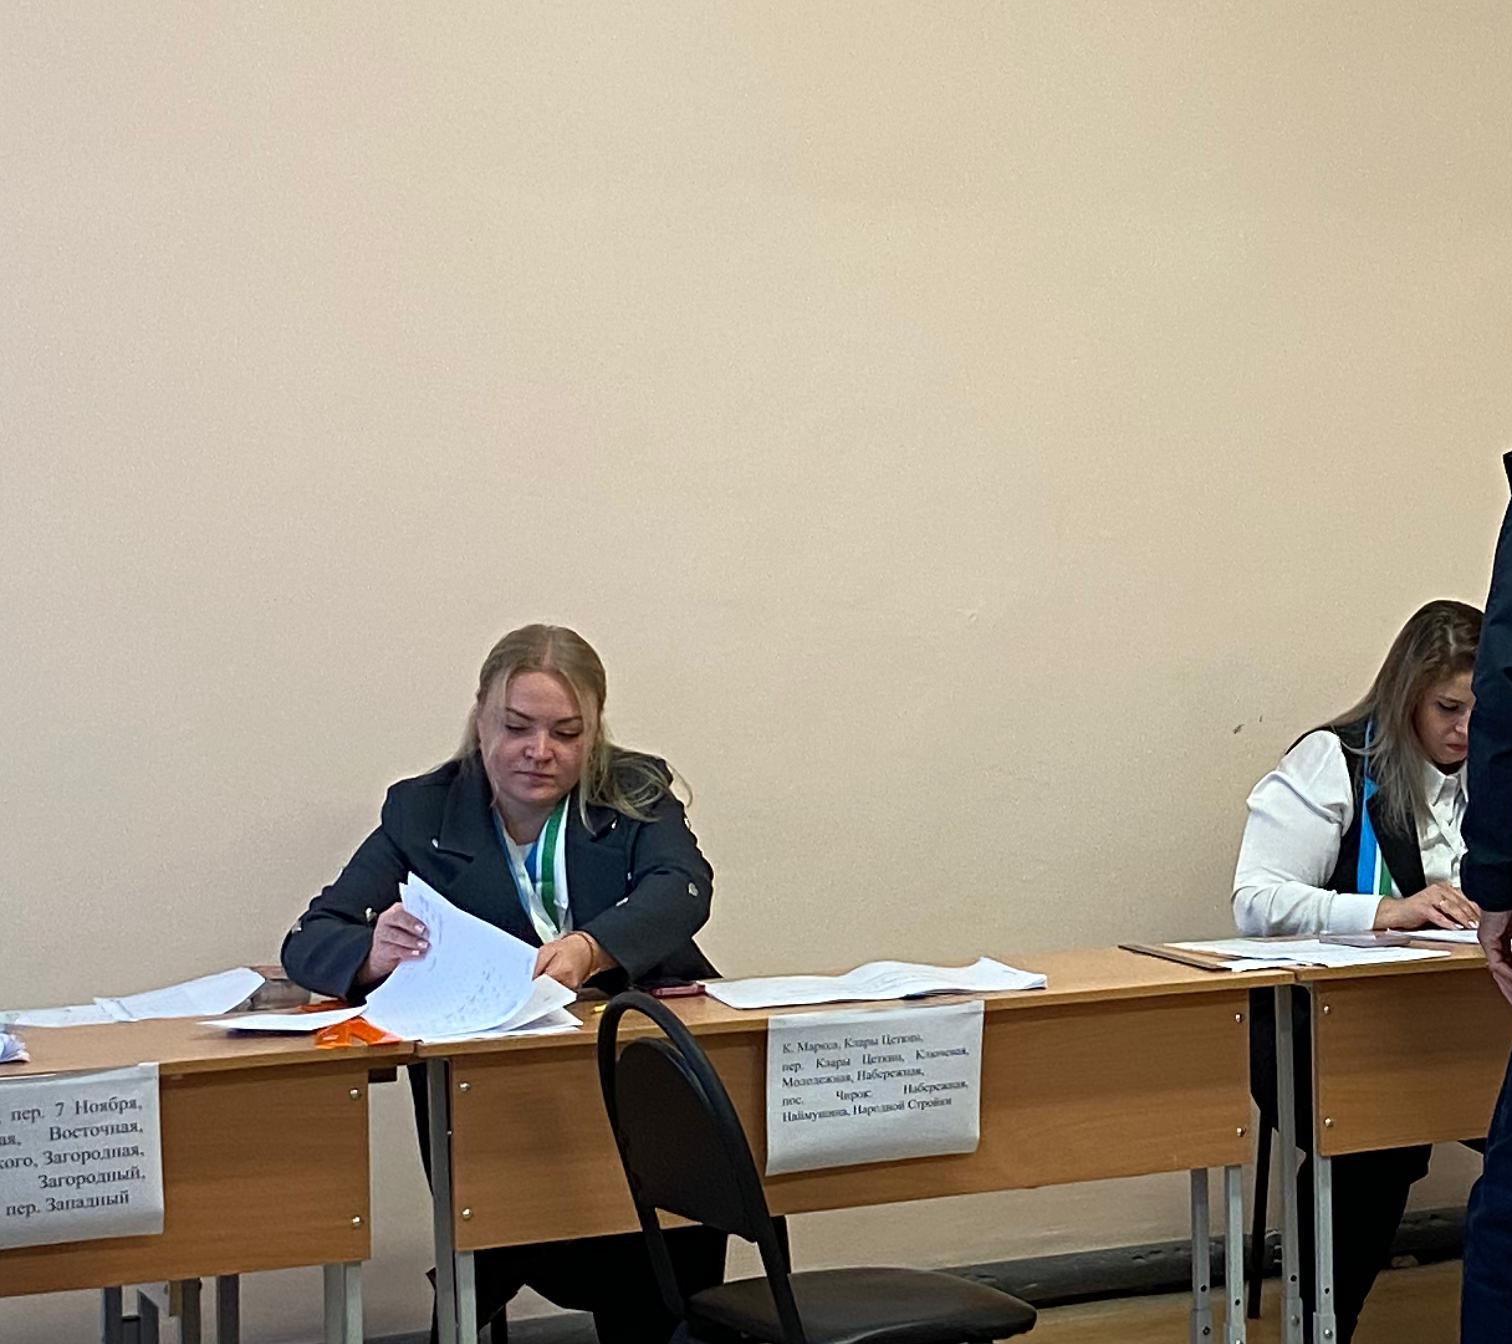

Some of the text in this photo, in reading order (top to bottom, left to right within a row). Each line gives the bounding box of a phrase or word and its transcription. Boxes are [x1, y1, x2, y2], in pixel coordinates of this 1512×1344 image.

[10, 1097, 143, 1124] пер. 7 Ноября,
[49, 1121, 143, 1141] Восточная,
[43, 1145, 145, 1165] Загородная,
[38, 1166, 146, 1189] Загородный,
[6, 1190, 130, 1218] пер. Западный
